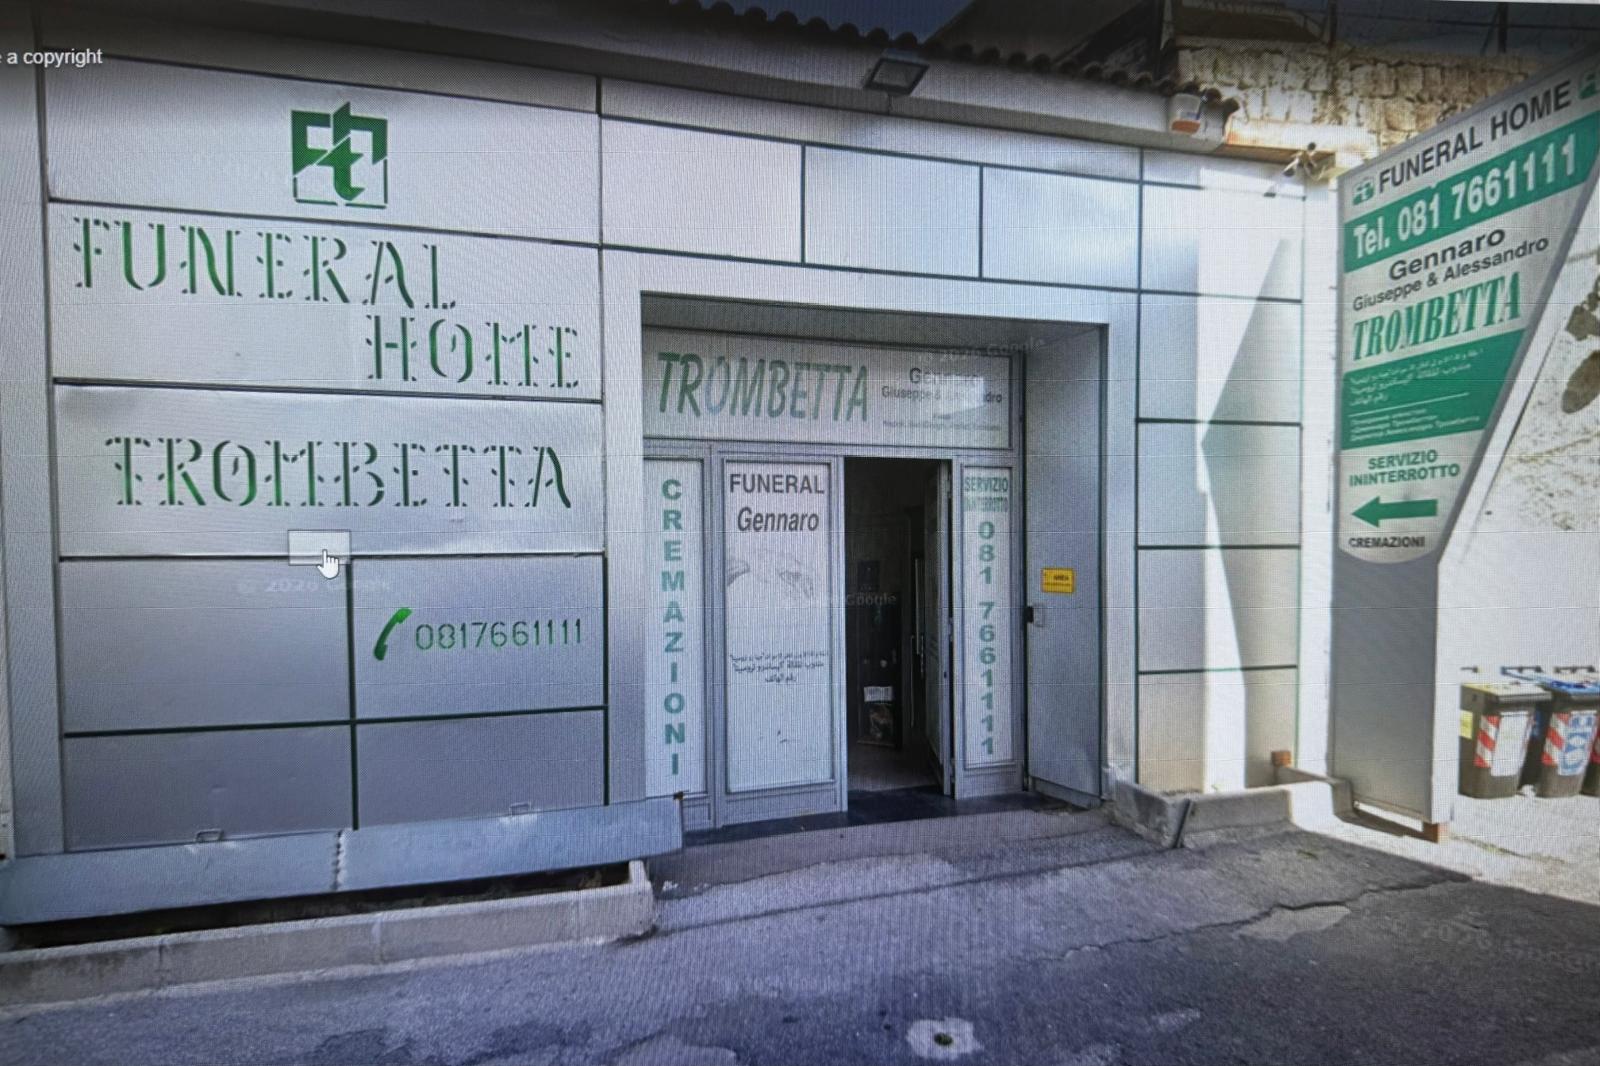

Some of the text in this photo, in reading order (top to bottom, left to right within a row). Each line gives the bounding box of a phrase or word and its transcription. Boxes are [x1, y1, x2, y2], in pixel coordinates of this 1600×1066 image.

[1378, 80, 1572, 194] FUNERAL HOME
[1353, 133, 1576, 259] Tel. 081 7661111
[73, 216, 457, 310] FUNERAL
[1353, 236, 1549, 312] Giuseppe & Alessandro
[1388, 229, 1506, 281] Gennaro
[365, 313, 579, 389] HOME
[1352, 271, 1521, 361] TROMBETTA
[656, 351, 869, 422] TROMBETTA
[105, 437, 572, 509] TROMBETTA
[729, 474, 825, 496] FUNERAL
[964, 476, 1009, 493] SERVIZIO
[1349, 464, 1460, 486] ININTERROTTO
[1368, 449, 1438, 471] SERVIZIO
[737, 507, 819, 533] Gennaro
[1348, 536, 1426, 548] CREMAZIONI
[415, 617, 583, 651] 0817661111
[661, 478, 685, 776] CREMAZIONI
